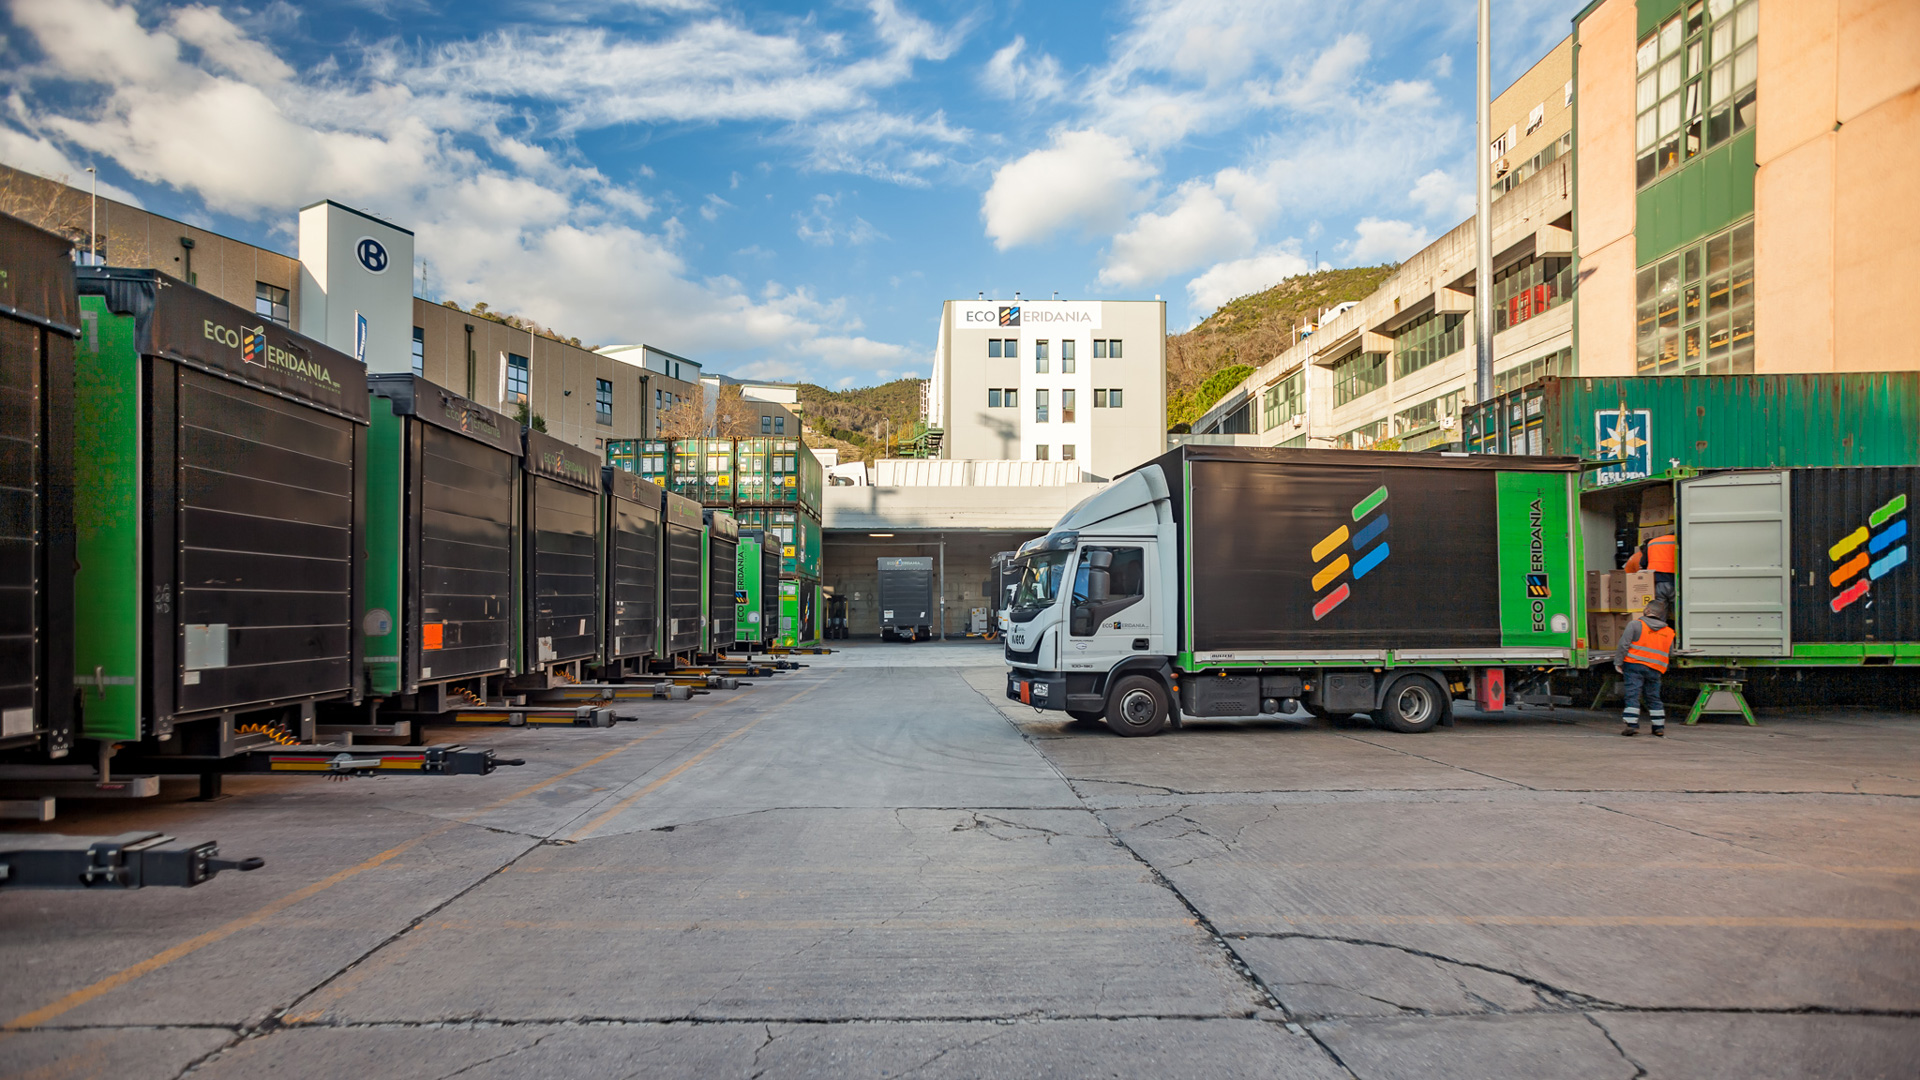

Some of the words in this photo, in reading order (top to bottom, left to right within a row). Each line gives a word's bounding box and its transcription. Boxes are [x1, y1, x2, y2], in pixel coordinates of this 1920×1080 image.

[966, 310, 996, 323] ECO
[1023, 310, 1092, 323] ERIDANIA
[203, 319, 240, 349] ECO
[267, 345, 332, 384] ERIDANIA
[1530, 499, 1543, 572] ERIDANIA
[737, 551, 745, 590] ERIDANIA
[737, 605, 745, 623] ECO
[1532, 600, 1545, 632] ECO
